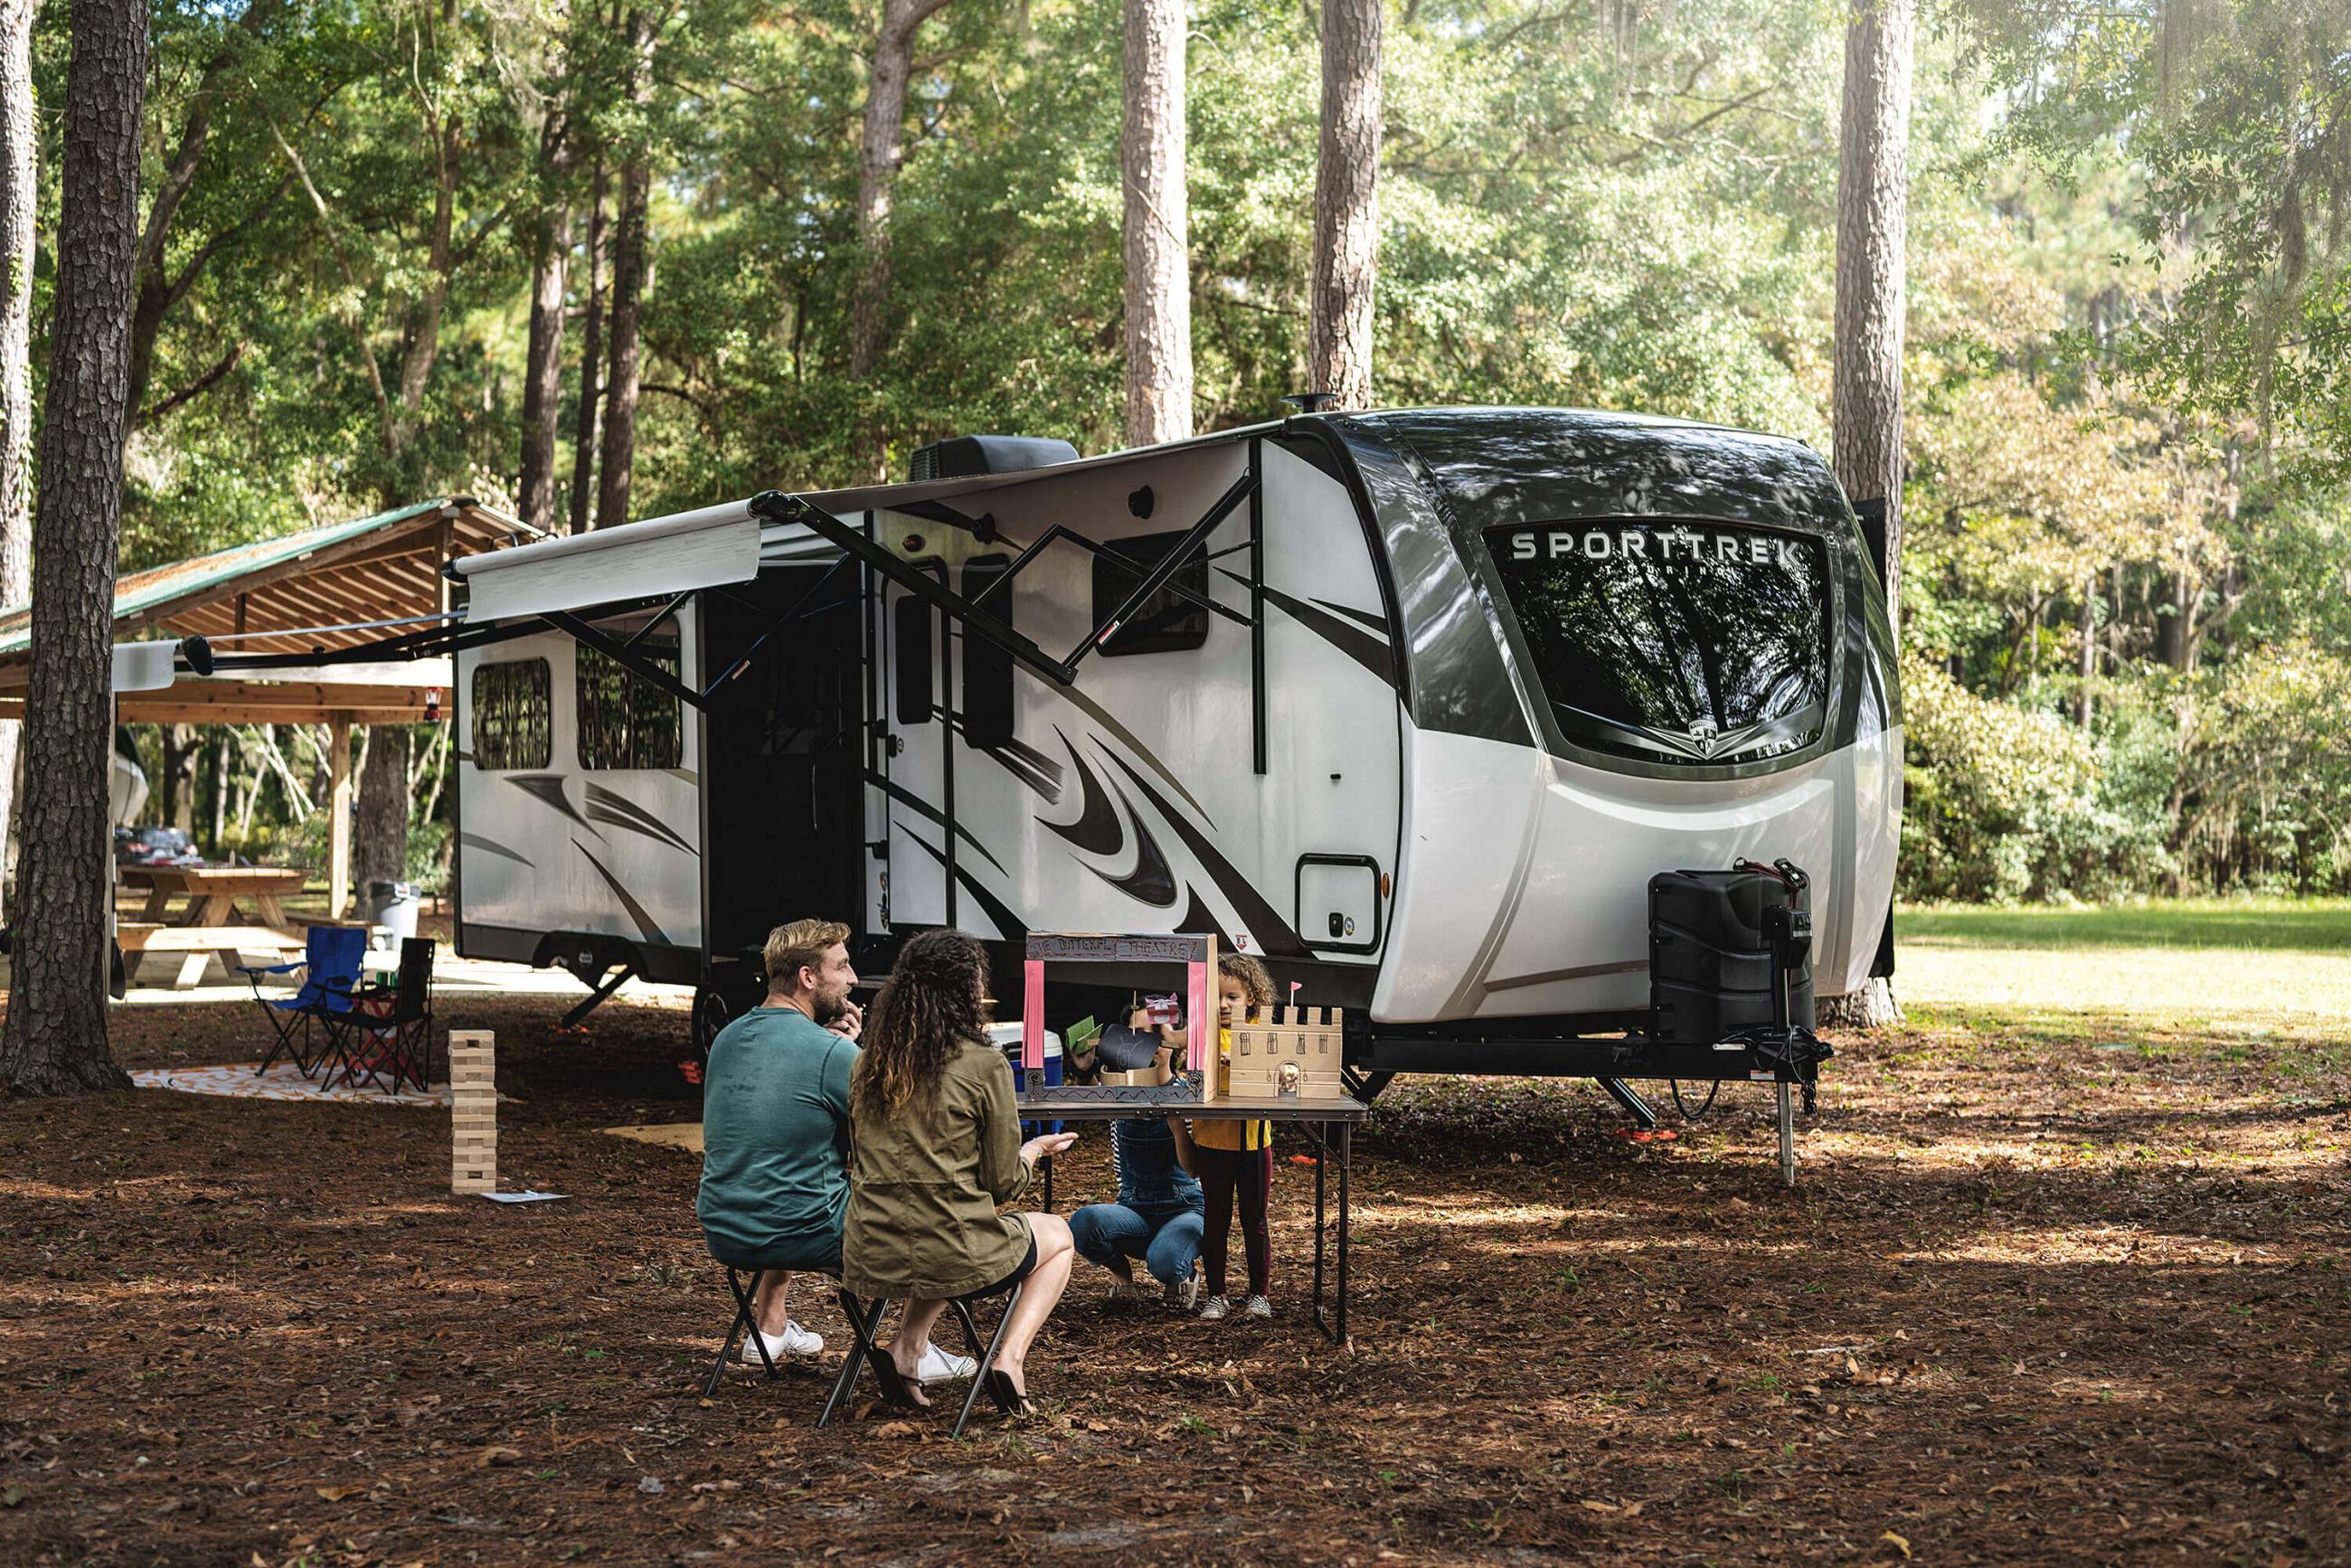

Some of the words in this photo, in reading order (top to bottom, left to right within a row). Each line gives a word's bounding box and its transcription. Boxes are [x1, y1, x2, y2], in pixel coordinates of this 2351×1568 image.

[1512, 532, 1801, 567] SPORTTREK
[1605, 563, 1725, 576] TOURING
[1128, 940, 1187, 956] THEATRE
